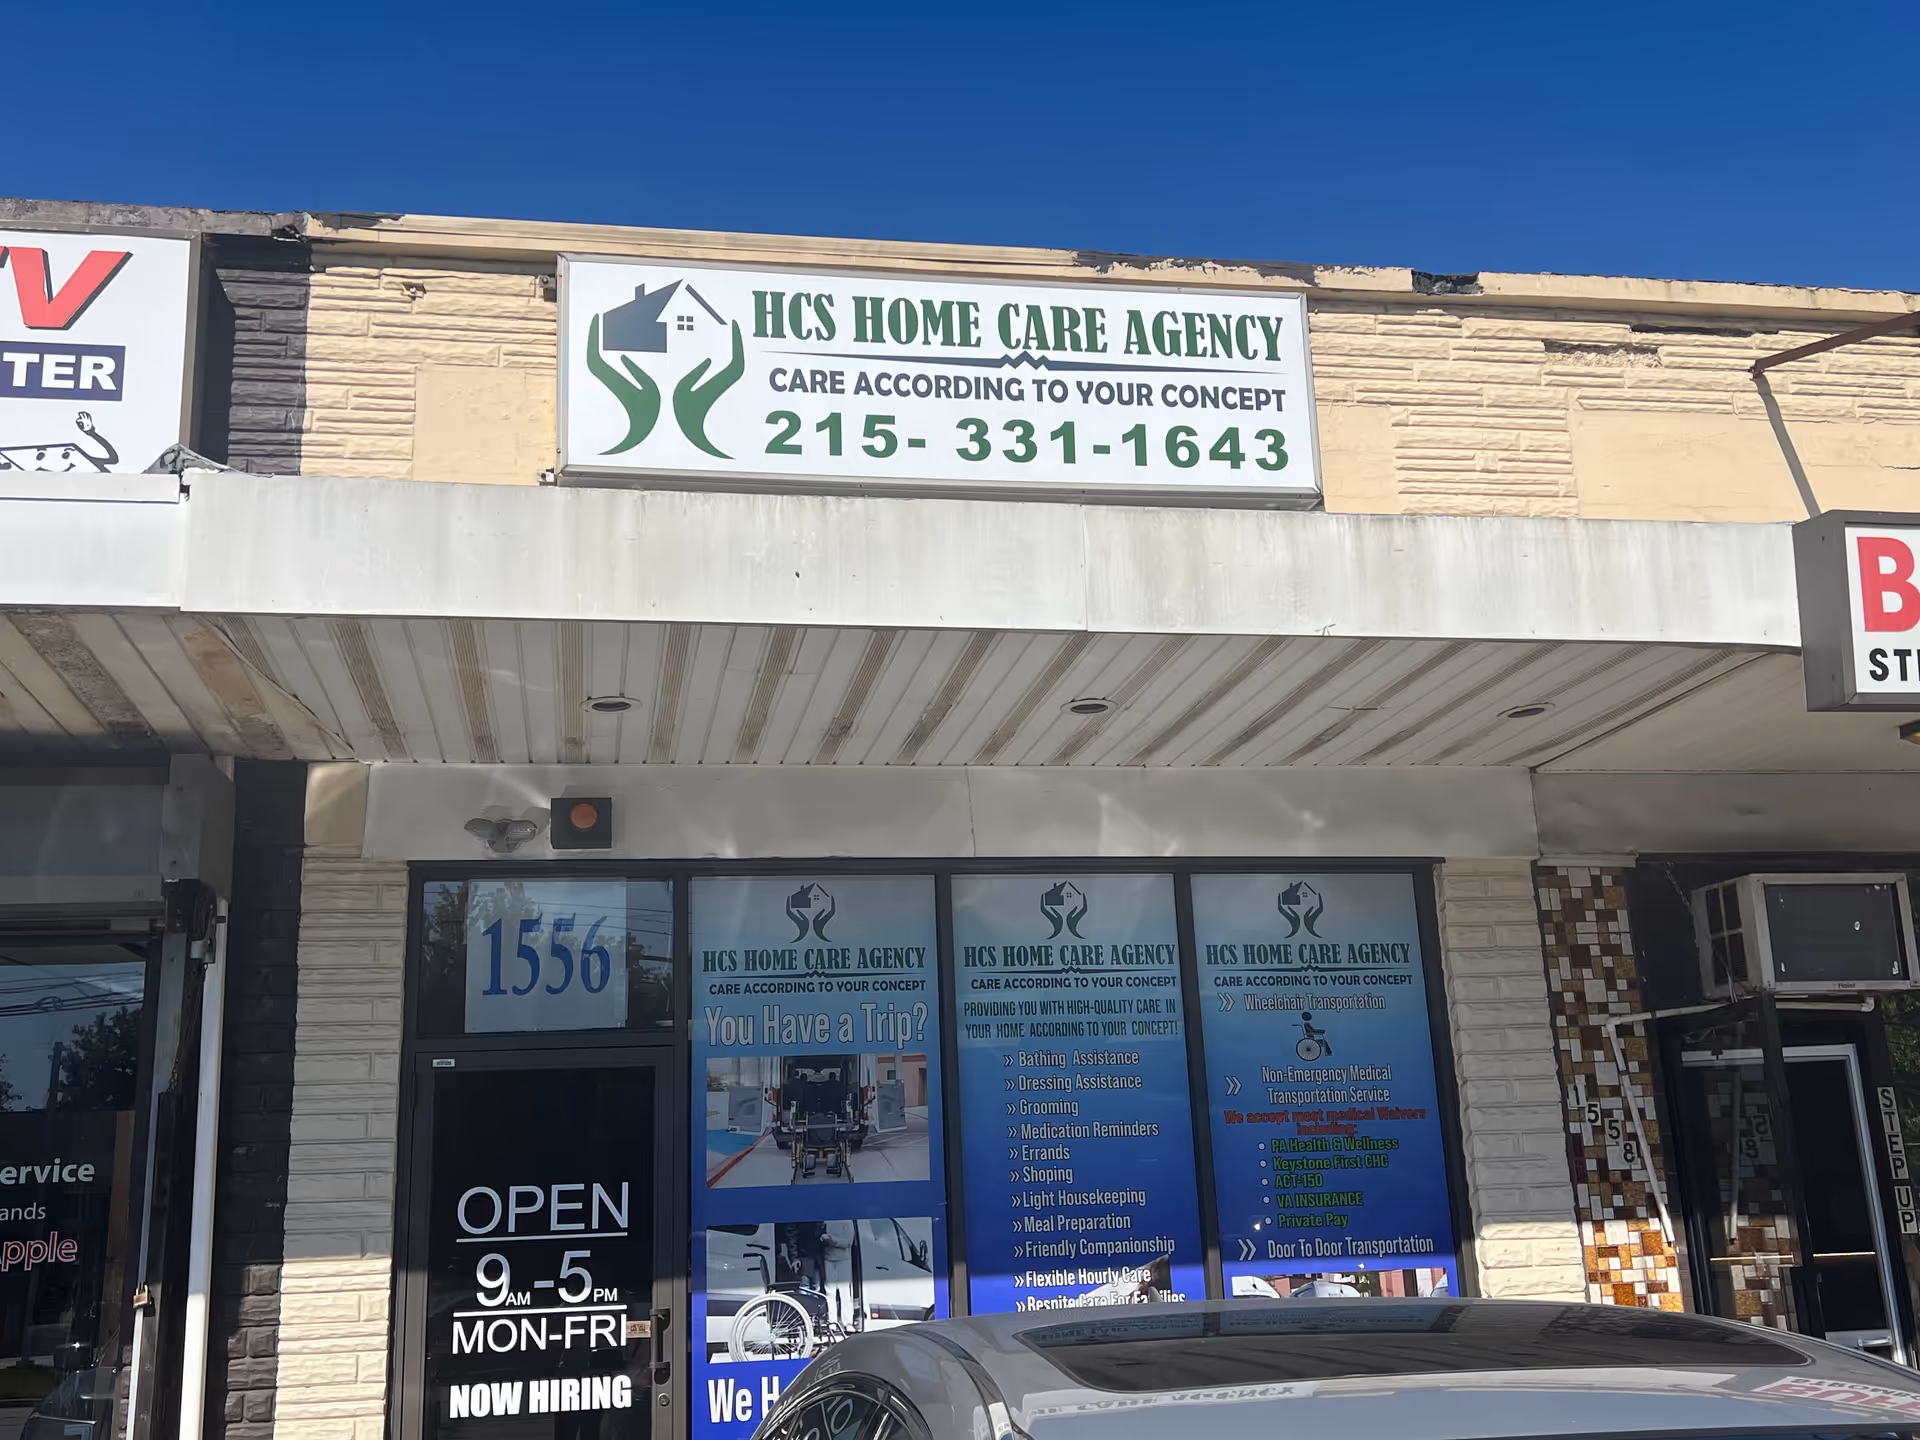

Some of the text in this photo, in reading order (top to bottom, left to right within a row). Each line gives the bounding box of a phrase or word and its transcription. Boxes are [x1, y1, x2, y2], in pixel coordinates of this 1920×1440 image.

[0, 246, 134, 330] V
[751, 290, 1284, 361] HCS HOME CARE AGENCY
[3, 352, 117, 390] TER
[769, 367, 1287, 412] CARE ACCORDING TO YOUR CONCEPT
[764, 410, 1289, 471] 215- 331-1643
[1869, 648, 1920, 681] ST
[482, 912, 611, 996] 1556
[703, 947, 926, 972] HCS HOME CARE AGENCY
[964, 944, 1176, 967] HCS HOME CARE AGENCY
[1206, 942, 1410, 965] HCS HOME CARE AGENCY
[709, 979, 926, 995] CARE ACCORDING TO YOUR CONCEPT
[971, 976, 1177, 990] CARE ACCORDING TO YOUR CONCEPT
[1214, 974, 1412, 987] CARE ACCORDING TO YOUR CONCEPT
[964, 998, 1176, 1017] PROVIDING YOU WITH HIGH-QUALITY CARE IN
[1243, 993, 1386, 1012] Wheelchair Transportation
[704, 1001, 928, 1050] You Have a Trip?
[965, 1020, 1178, 1039] YOUR HOME ACCORDING TO YOUR CONCEPT!
[1018, 1049, 1140, 1069] Bathing Assistance
[1018, 1073, 1142, 1093] Dressing Assistance
[1262, 1063, 1392, 1085] Non-Emergency Medical
[1267, 1086, 1390, 1106] Transportation Service
[1019, 1099, 1079, 1117] Grooming
[1224, 1106, 1426, 1125] We accept most medical Waivers
[1021, 1121, 1159, 1140] Medication Reminders
[1022, 1144, 1071, 1161] Errands
[1271, 1136, 1399, 1153] PA Health & Wellness
[1273, 1154, 1389, 1173] Keystone First CHC
[1880, 1088, 1914, 1232] STEP UP
[0, 1158, 95, 1185] ervice
[1023, 1166, 1074, 1184] Shoping
[1275, 1173, 1324, 1189] ACT-150
[457, 1182, 629, 1235] OPEN
[1023, 1188, 1146, 1210] Light Housekeeping
[1276, 1192, 1364, 1209] VA INSURANCE
[0, 1202, 46, 1220] ands
[1278, 1212, 1349, 1229] Private Pay
[1024, 1213, 1131, 1233] Meal Preparation
[0, 1232, 78, 1272] pple
[1025, 1236, 1176, 1259] Friendly Companionship
[1267, 1235, 1434, 1259] Door To Door Transportation
[1026, 1266, 1151, 1288] Flexible Hourly Care
[1134, 1290, 1186, 1304] Failies
[452, 1313, 627, 1354] MON-FRI
[450, 1375, 632, 1418] NOW HIRING
[707, 1378, 752, 1423] We
